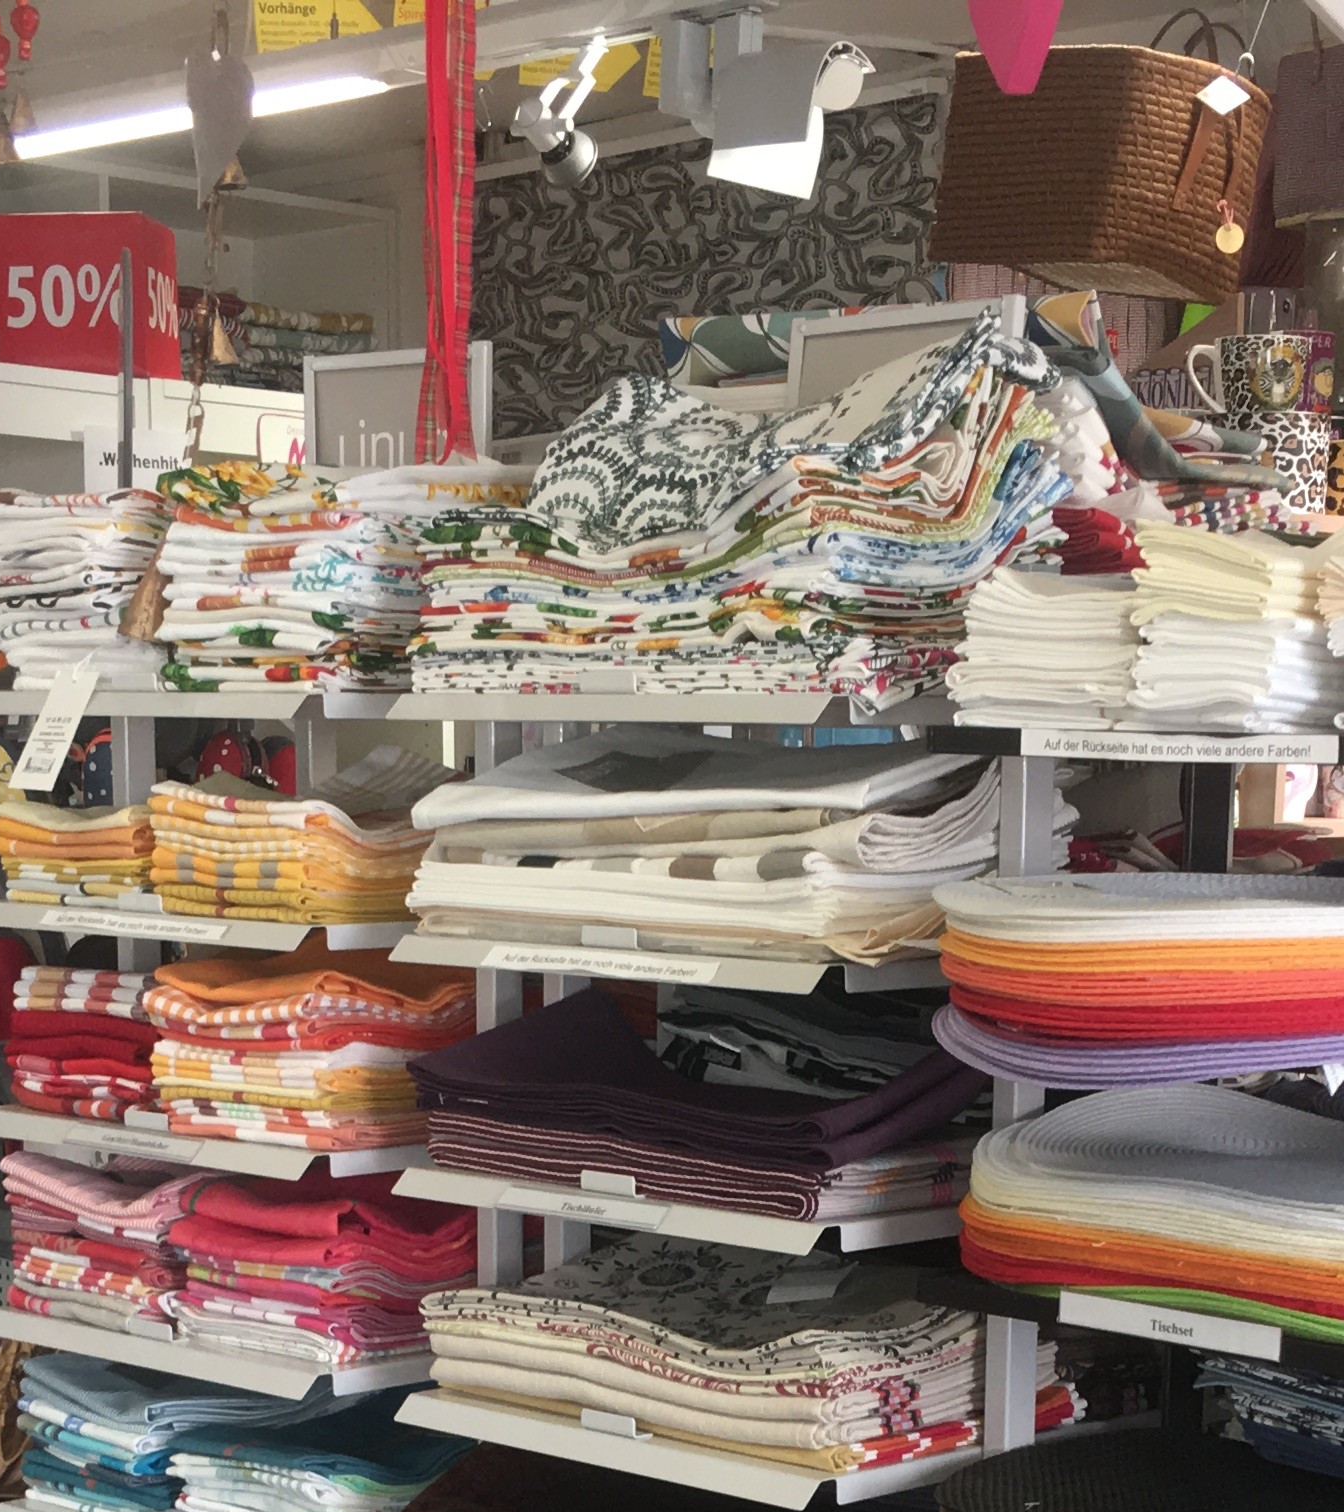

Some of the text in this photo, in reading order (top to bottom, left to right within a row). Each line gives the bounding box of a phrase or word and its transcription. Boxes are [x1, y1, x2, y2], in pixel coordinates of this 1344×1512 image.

[258, 1, 316, 17] Vorhänge
[7, 263, 122, 328] 50%
[147, 266, 178, 339] 50%
[1044, 737, 1312, 758] Auf der Rückseite hat es noch viele andere Farben!
[1149, 1318, 1194, 1338] Tischset
